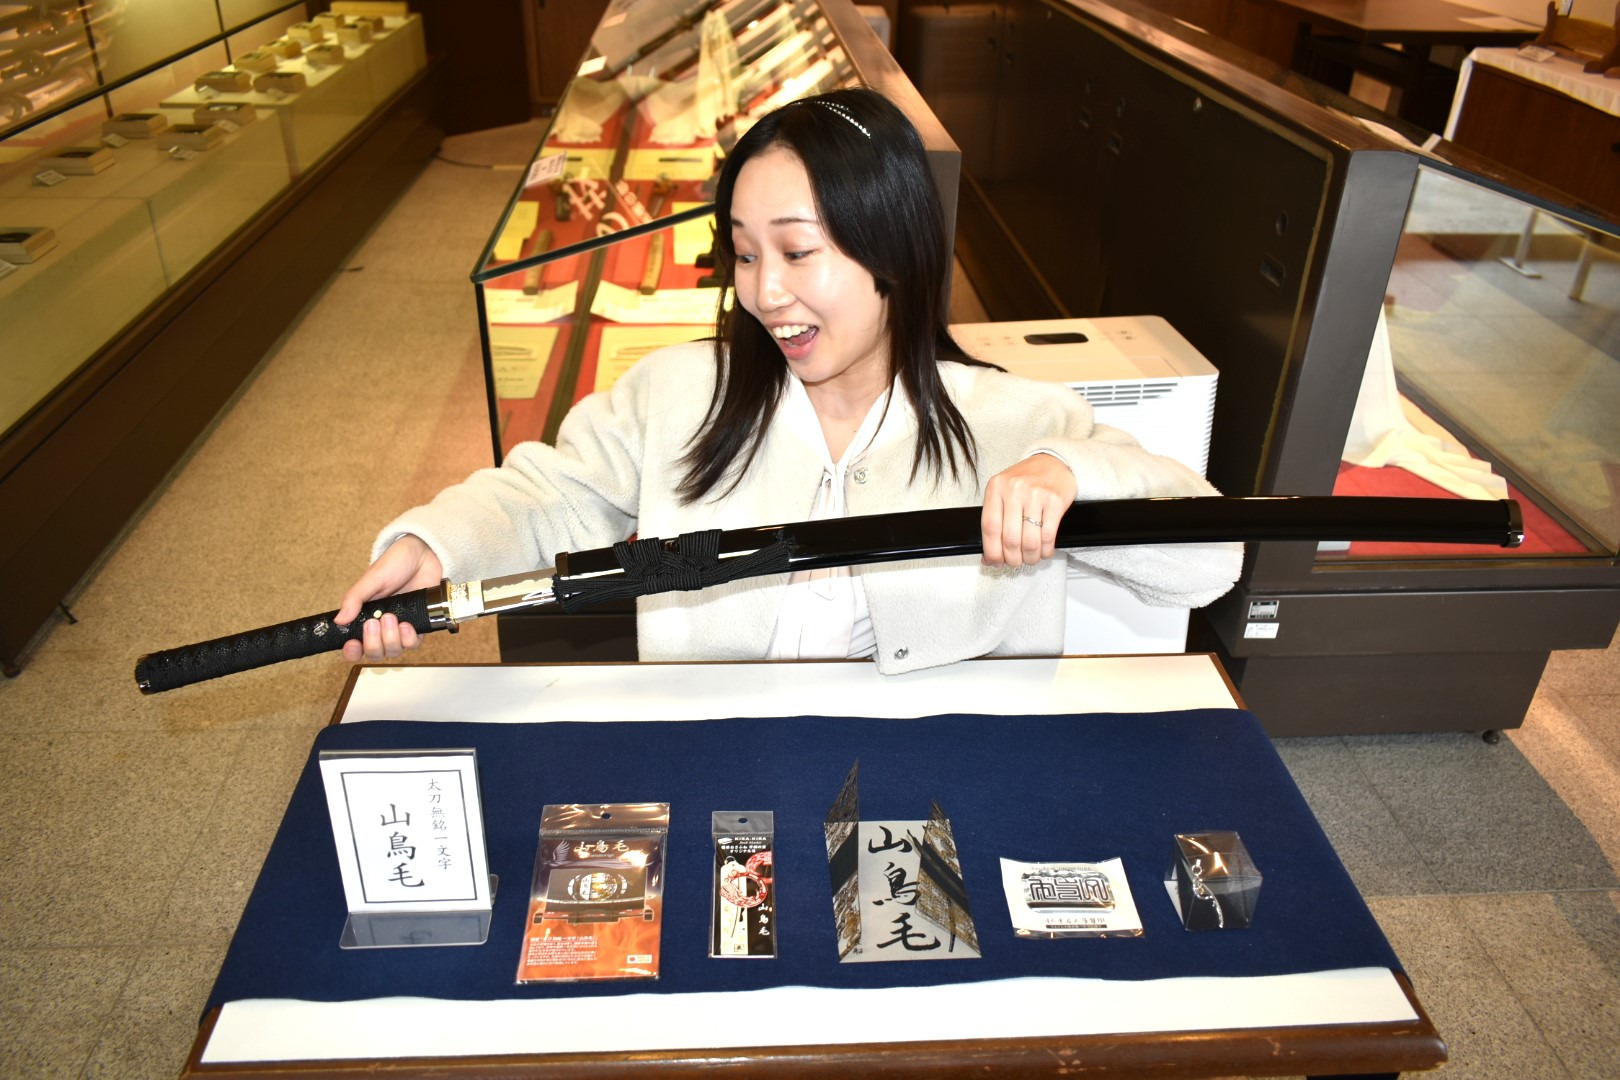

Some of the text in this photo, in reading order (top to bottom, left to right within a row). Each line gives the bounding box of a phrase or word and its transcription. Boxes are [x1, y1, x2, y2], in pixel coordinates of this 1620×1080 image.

[380, 803, 425, 888] 山鳥毛
[428, 779, 452, 870] 太刀無銘一文字
[758, 903, 770, 936] 山鳥毛
[868, 825, 941, 951] 山鳥毛
